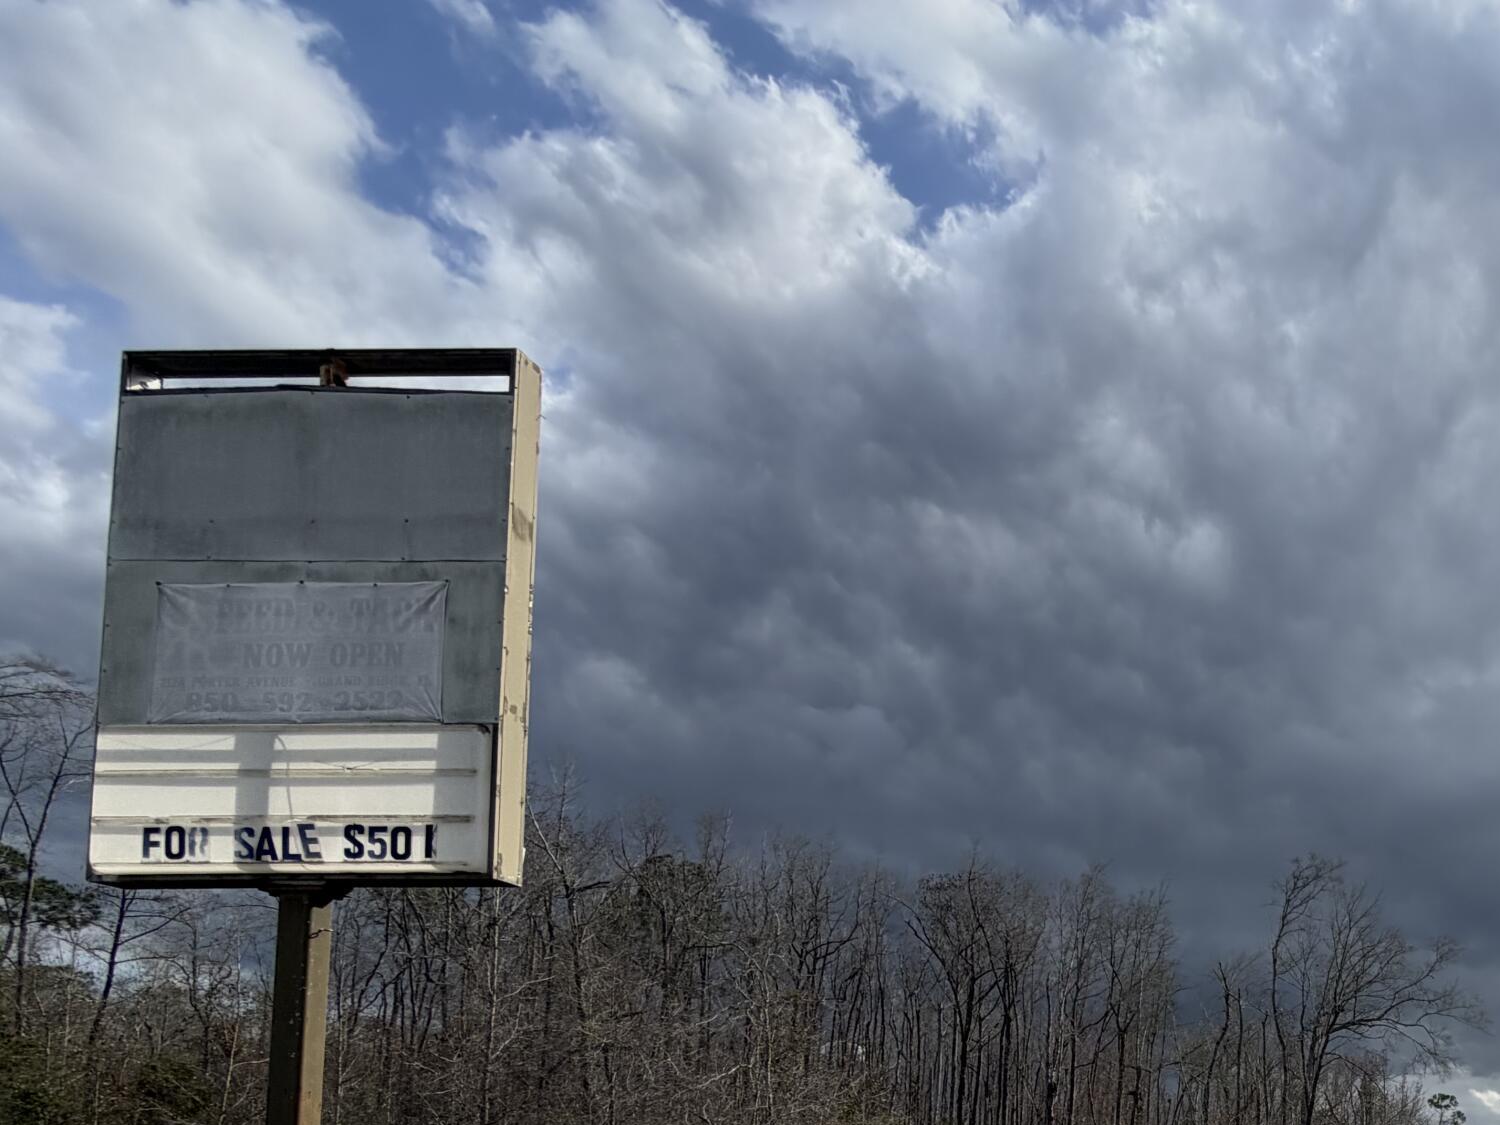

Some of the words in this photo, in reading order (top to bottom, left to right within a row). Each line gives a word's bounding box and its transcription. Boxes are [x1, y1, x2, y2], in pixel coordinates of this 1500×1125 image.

[243, 642, 314, 668] NOW
[329, 642, 405, 668] OPEN
[142, 825, 209, 860] FOR
[234, 823, 322, 861] SALE
